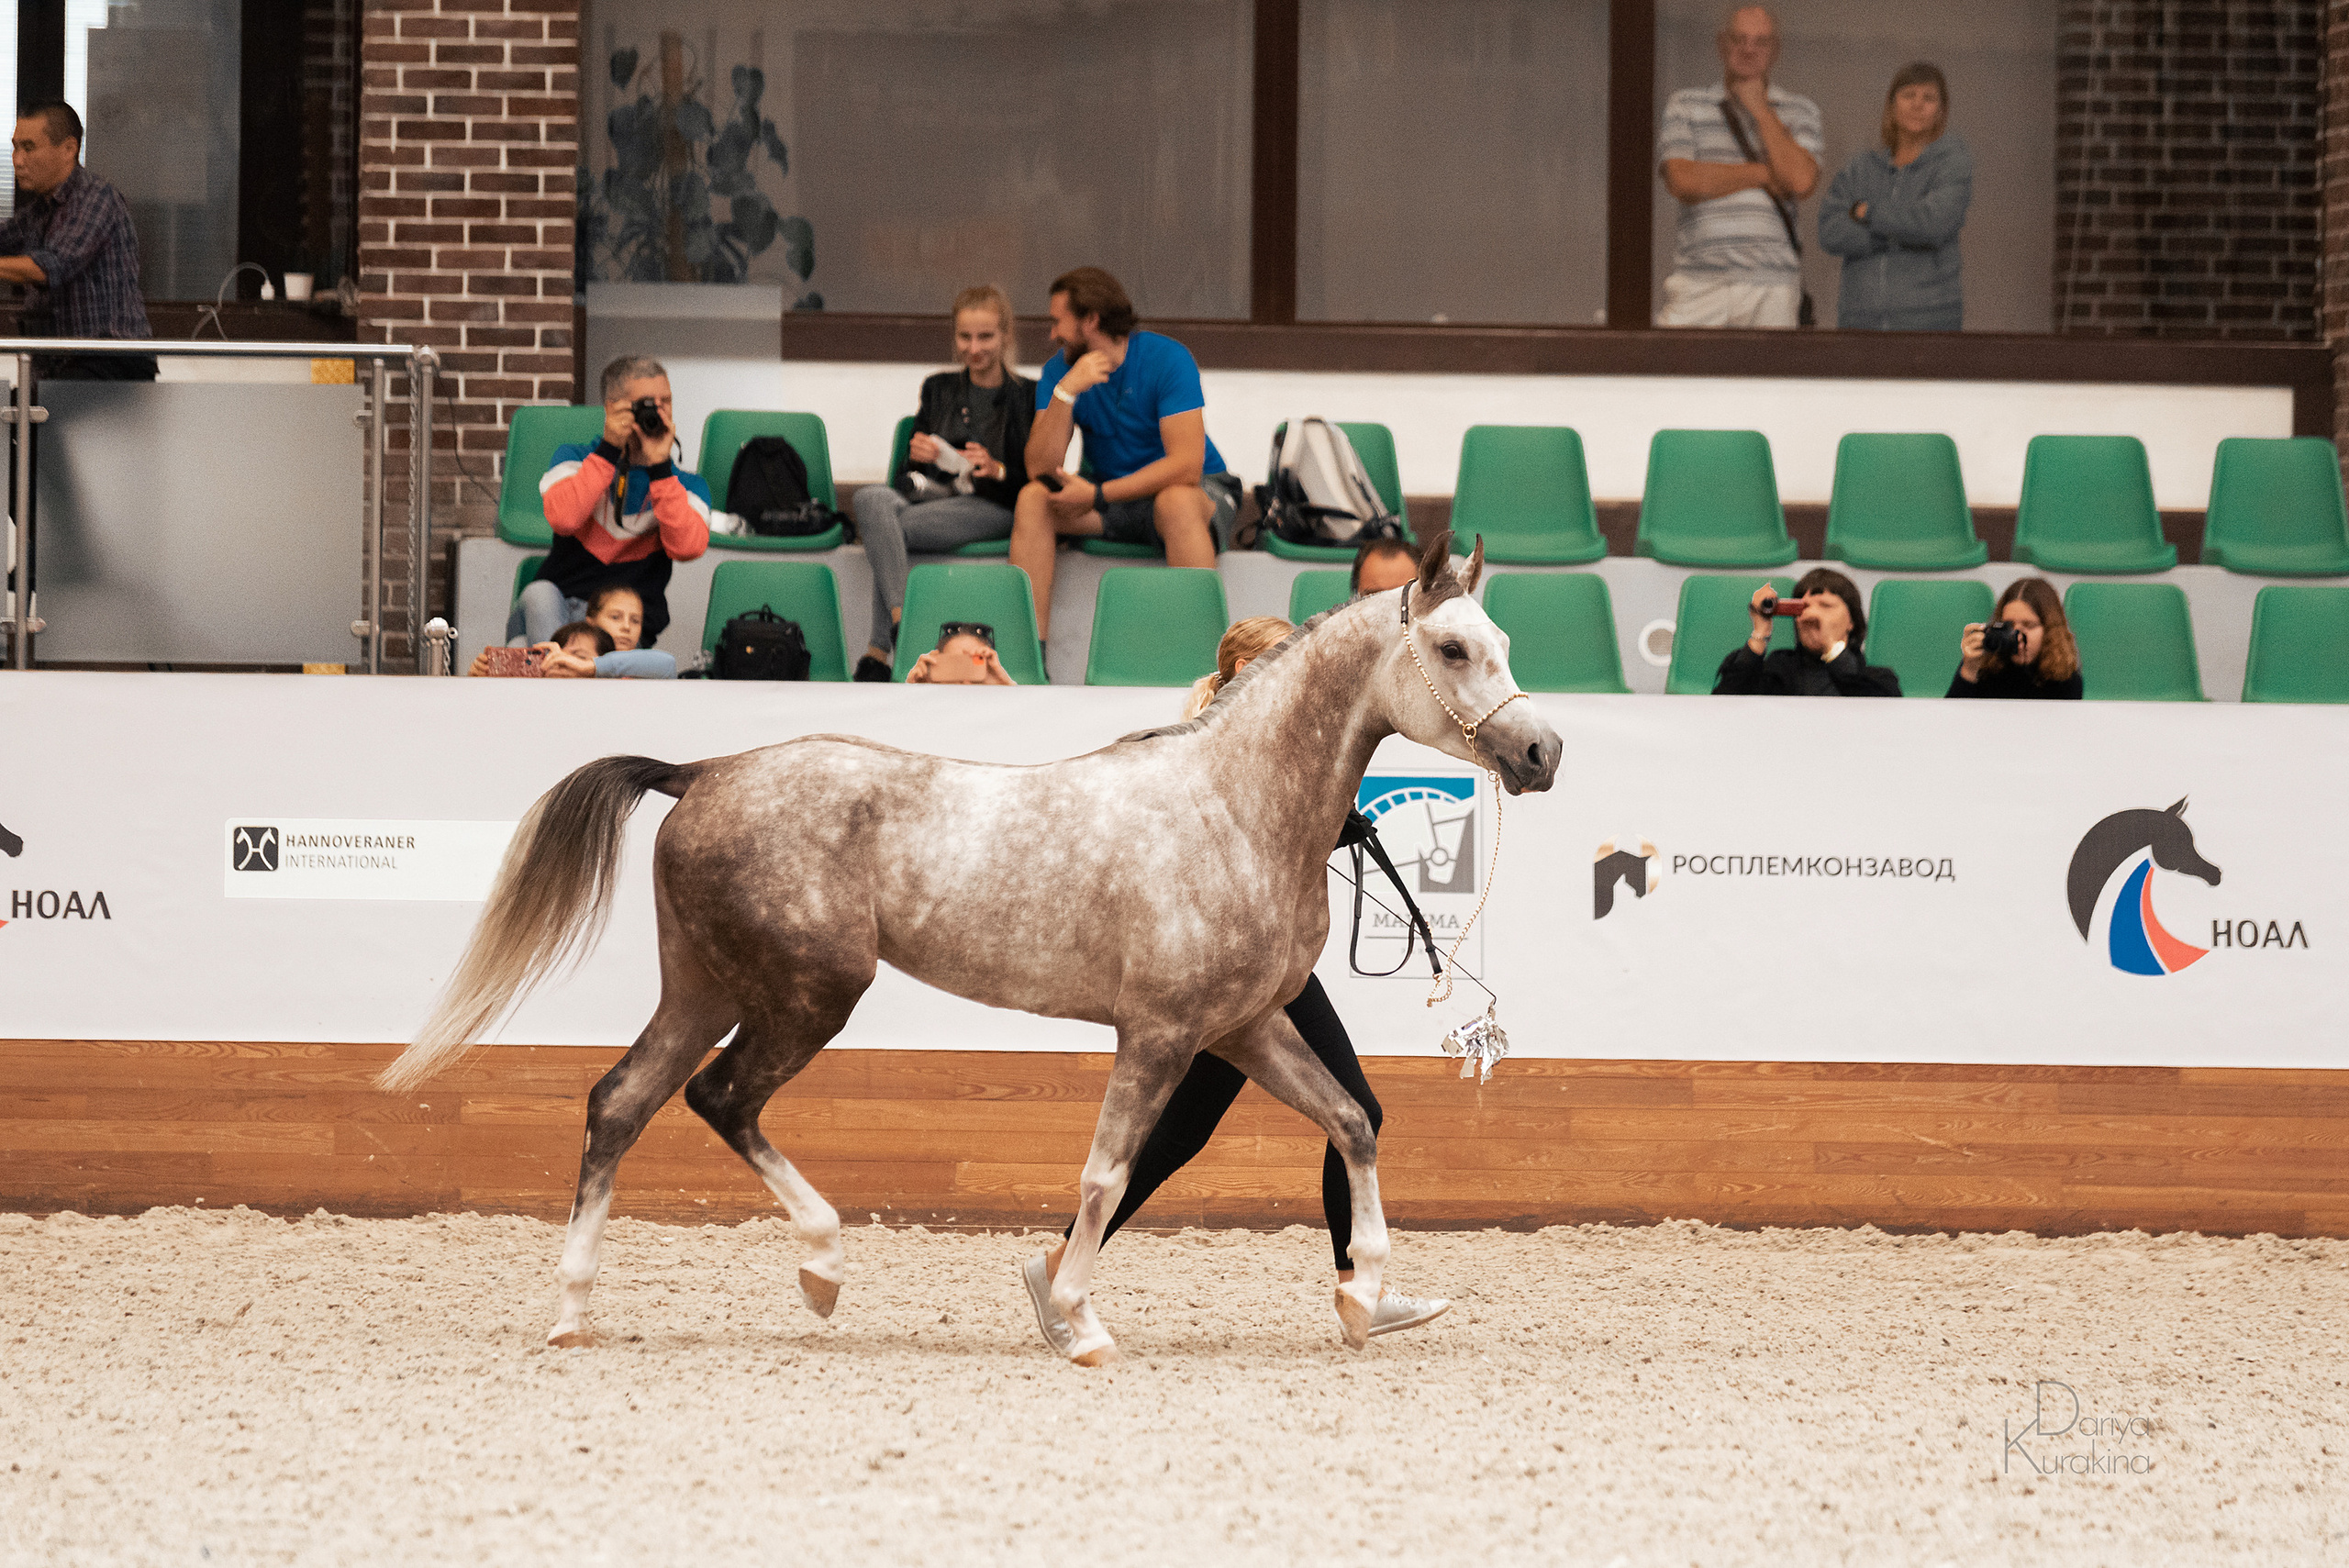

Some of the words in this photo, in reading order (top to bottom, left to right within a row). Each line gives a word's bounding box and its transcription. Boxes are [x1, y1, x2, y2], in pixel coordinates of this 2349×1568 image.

[285, 834, 416, 849] HANNOVERANER
[284, 854, 397, 869] INTERNATIONAL
[1673, 854, 1955, 882] РОСПЛЕМКОНЗАВОД
[1373, 913, 1459, 929] MAMA
